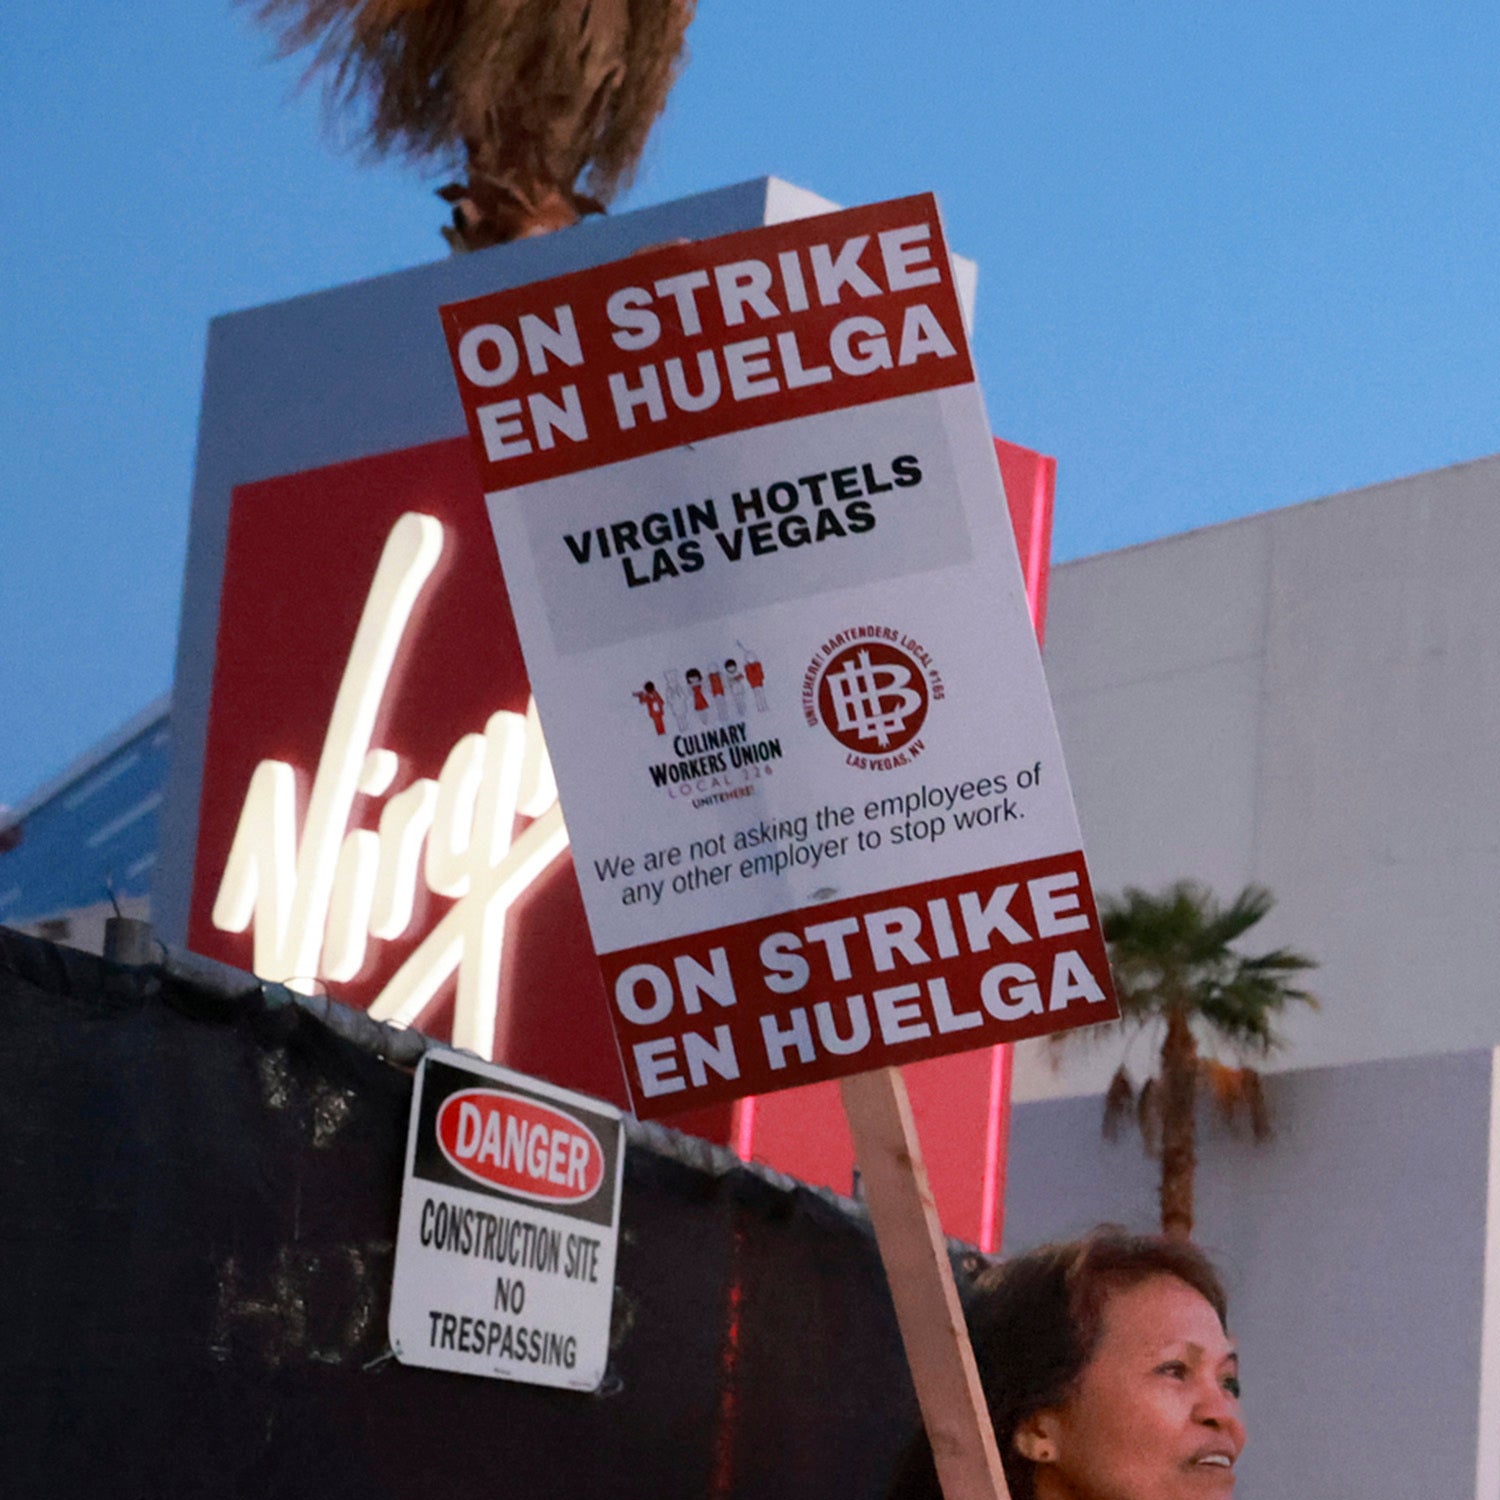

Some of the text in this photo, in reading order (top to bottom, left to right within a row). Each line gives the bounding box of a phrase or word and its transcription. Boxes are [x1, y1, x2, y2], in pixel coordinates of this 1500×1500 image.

[457, 223, 942, 387] ON STRIKE
[475, 303, 957, 462] EN HUELGA
[563, 453, 923, 565] VIRGIN HOTELS
[622, 500, 877, 588] LAS VEGAS
[900, 635, 933, 669] LOCAL
[667, 776, 731, 799] LOCAL
[845, 754, 868, 770] LAS
[909, 739, 926, 757] NV
[594, 761, 1042, 882] We are not asking the employees of
[621, 798, 1025, 906] any other employer to stop work.
[614, 870, 1092, 1027] ON STRIKE
[632, 949, 1107, 1099] EN HUELGA
[455, 1101, 590, 1192] DANGER
[420, 1198, 601, 1284] CONSTRUCTION SITE
[428, 1310, 577, 1370] TRESPASSING
[494, 1276, 526, 1315] NO
